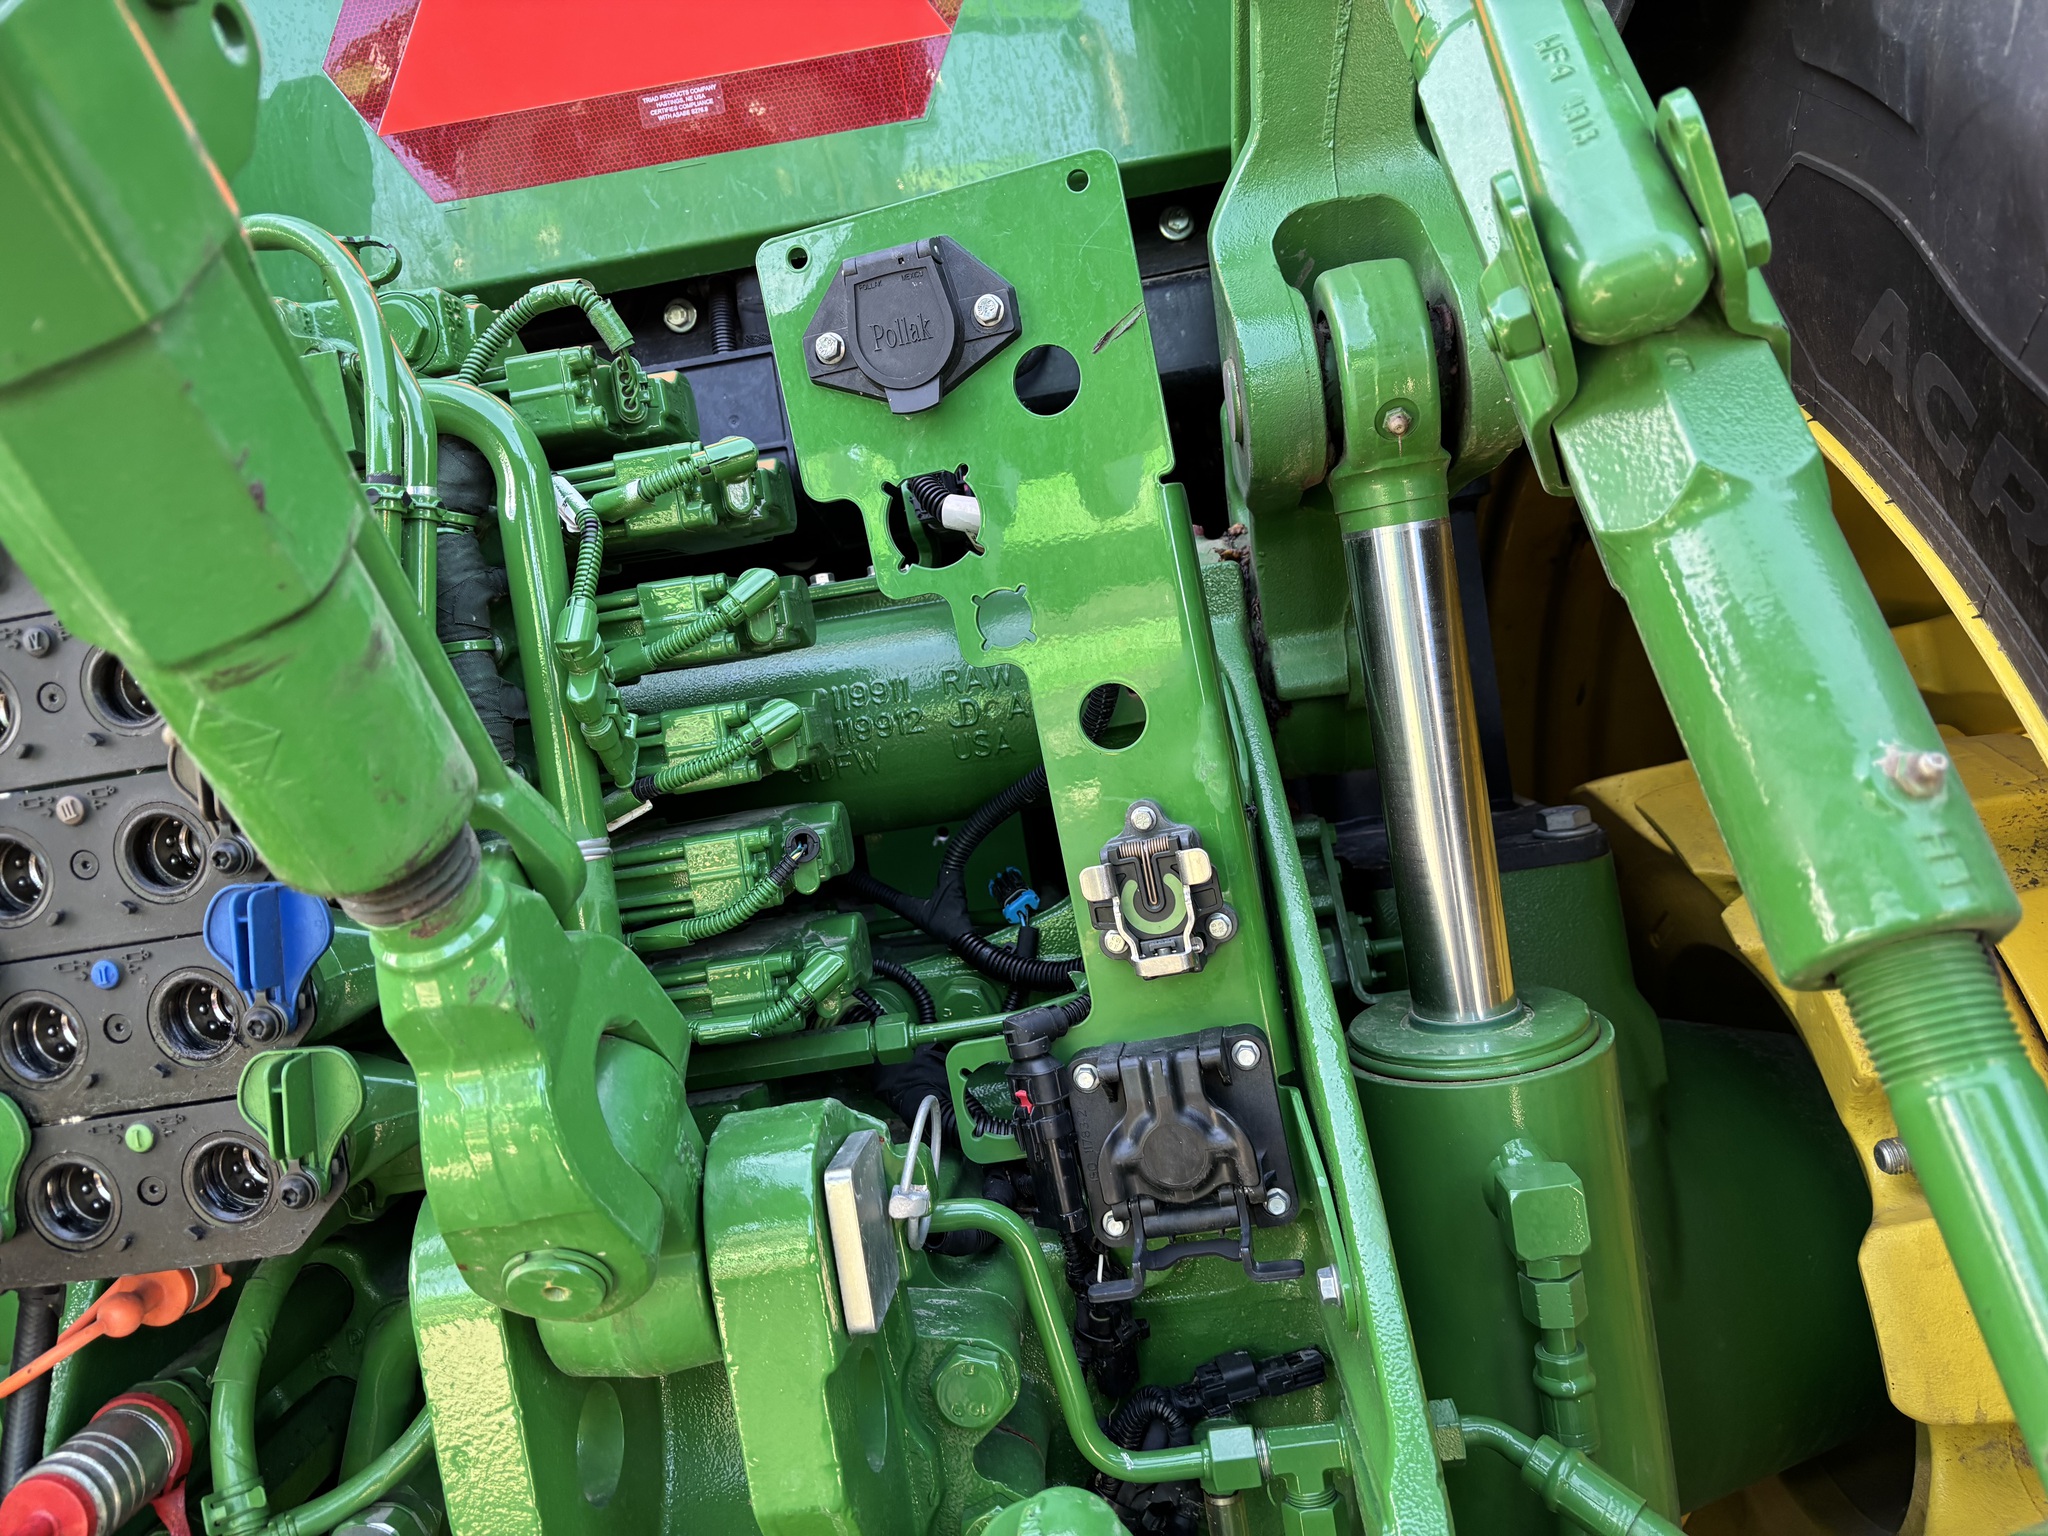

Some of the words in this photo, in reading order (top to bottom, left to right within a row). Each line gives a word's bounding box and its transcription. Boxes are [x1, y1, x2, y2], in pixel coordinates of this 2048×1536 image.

[642, 96, 660, 104] TRIAD
[659, 89, 690, 101] PRODUCTS
[690, 84, 717, 95] COMPANY
[650, 105, 678, 116] CERTIFIES
[678, 98, 714, 110] COMPLIANCE
[656, 98, 685, 108] HASTINGS,
[694, 93, 706, 101] USA
[868, 313, 934, 352] Pollak
[1851, 288, 2048, 603] ACR
[830, 675, 911, 711] 119911
[941, 663, 1012, 696] RAW
[834, 706, 926, 746] 119912
[951, 727, 1013, 761] USA
